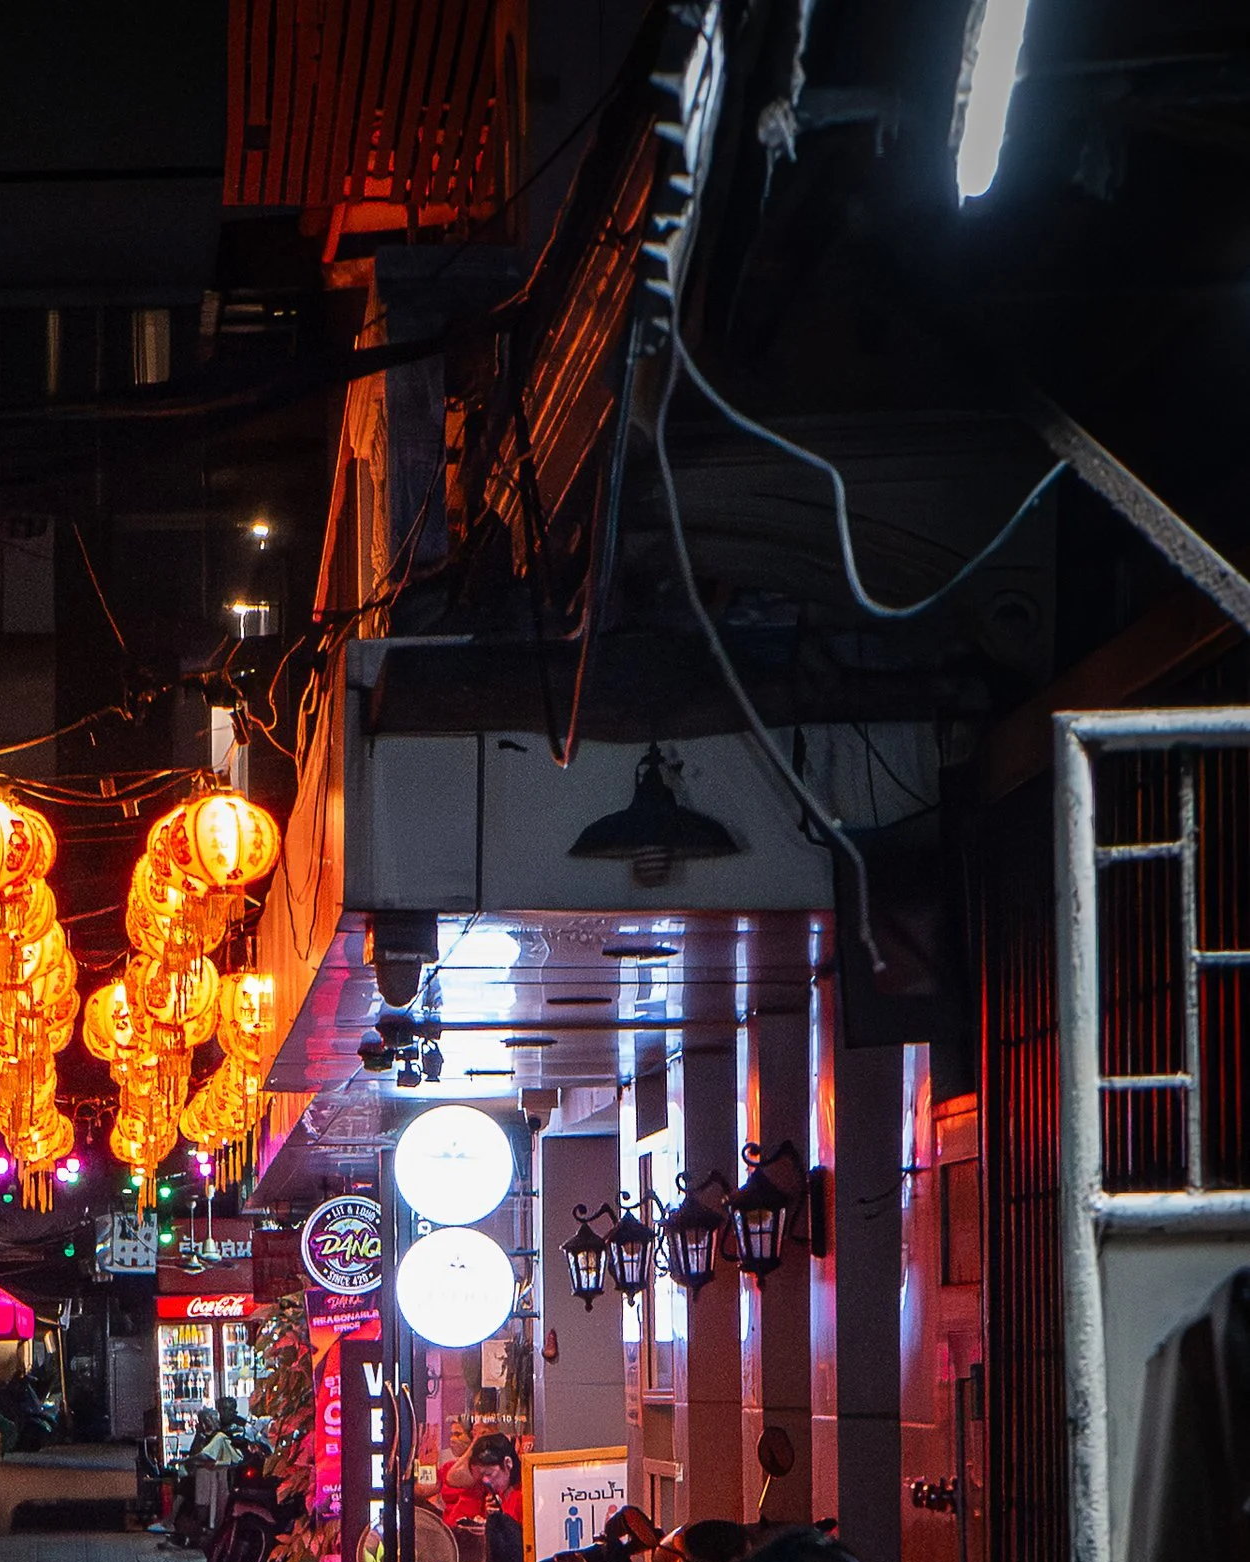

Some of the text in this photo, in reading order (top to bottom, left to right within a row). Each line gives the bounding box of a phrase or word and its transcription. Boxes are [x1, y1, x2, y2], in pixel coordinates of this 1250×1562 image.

[314, 1232, 382, 1262] DANQ
[327, 1271, 369, 1287] SINCE 420
[561, 1481, 624, 1503] ห้องน้ำ
